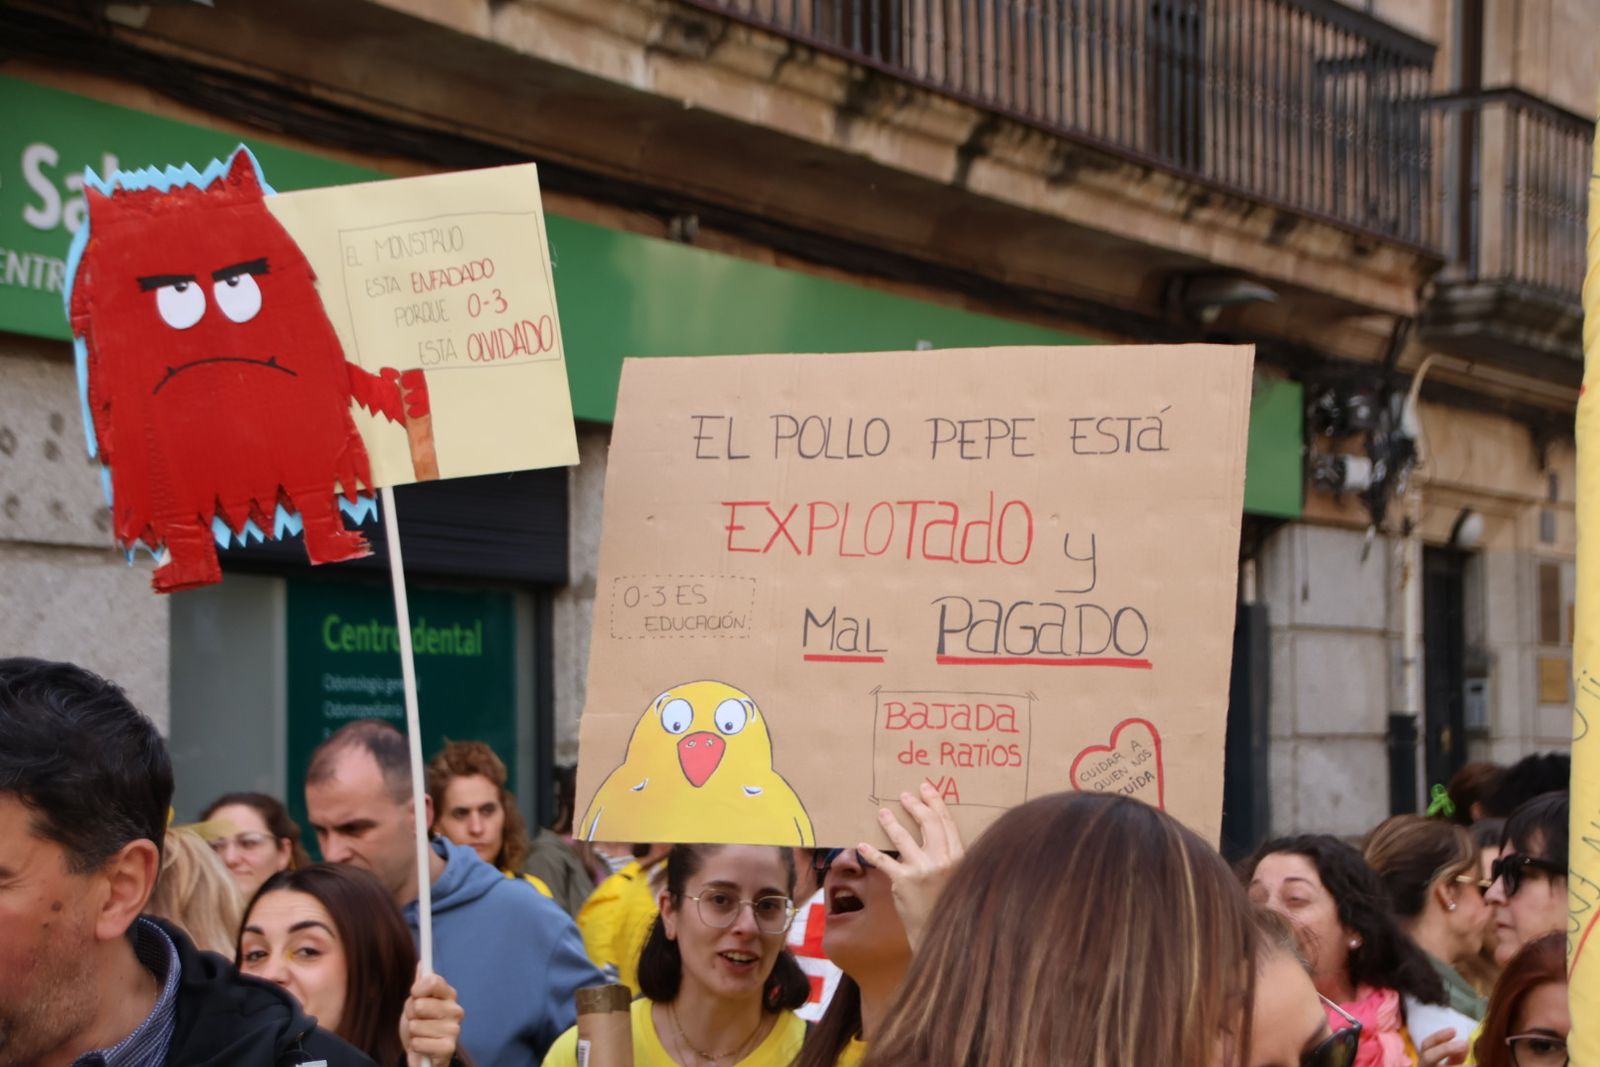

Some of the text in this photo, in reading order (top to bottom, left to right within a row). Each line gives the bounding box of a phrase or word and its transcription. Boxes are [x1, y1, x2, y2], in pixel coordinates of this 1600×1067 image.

[346, 225, 464, 267] EL MONSTRUO
[410, 258, 495, 294] ENFADADO
[394, 289, 508, 329] PORQUE 0-3
[467, 315, 554, 362] OLVIDADO
[691, 415, 750, 460] EL
[769, 414, 890, 460] POLLO
[924, 417, 1036, 460] PEPE
[1055, 533, 1096, 594] y
[623, 584, 708, 608] 0-3 ES
[644, 610, 746, 632] EDUCACIÓN
[897, 739, 931, 766] de
[1130, 740, 1142, 753] A
[925, 775, 960, 805] YA
